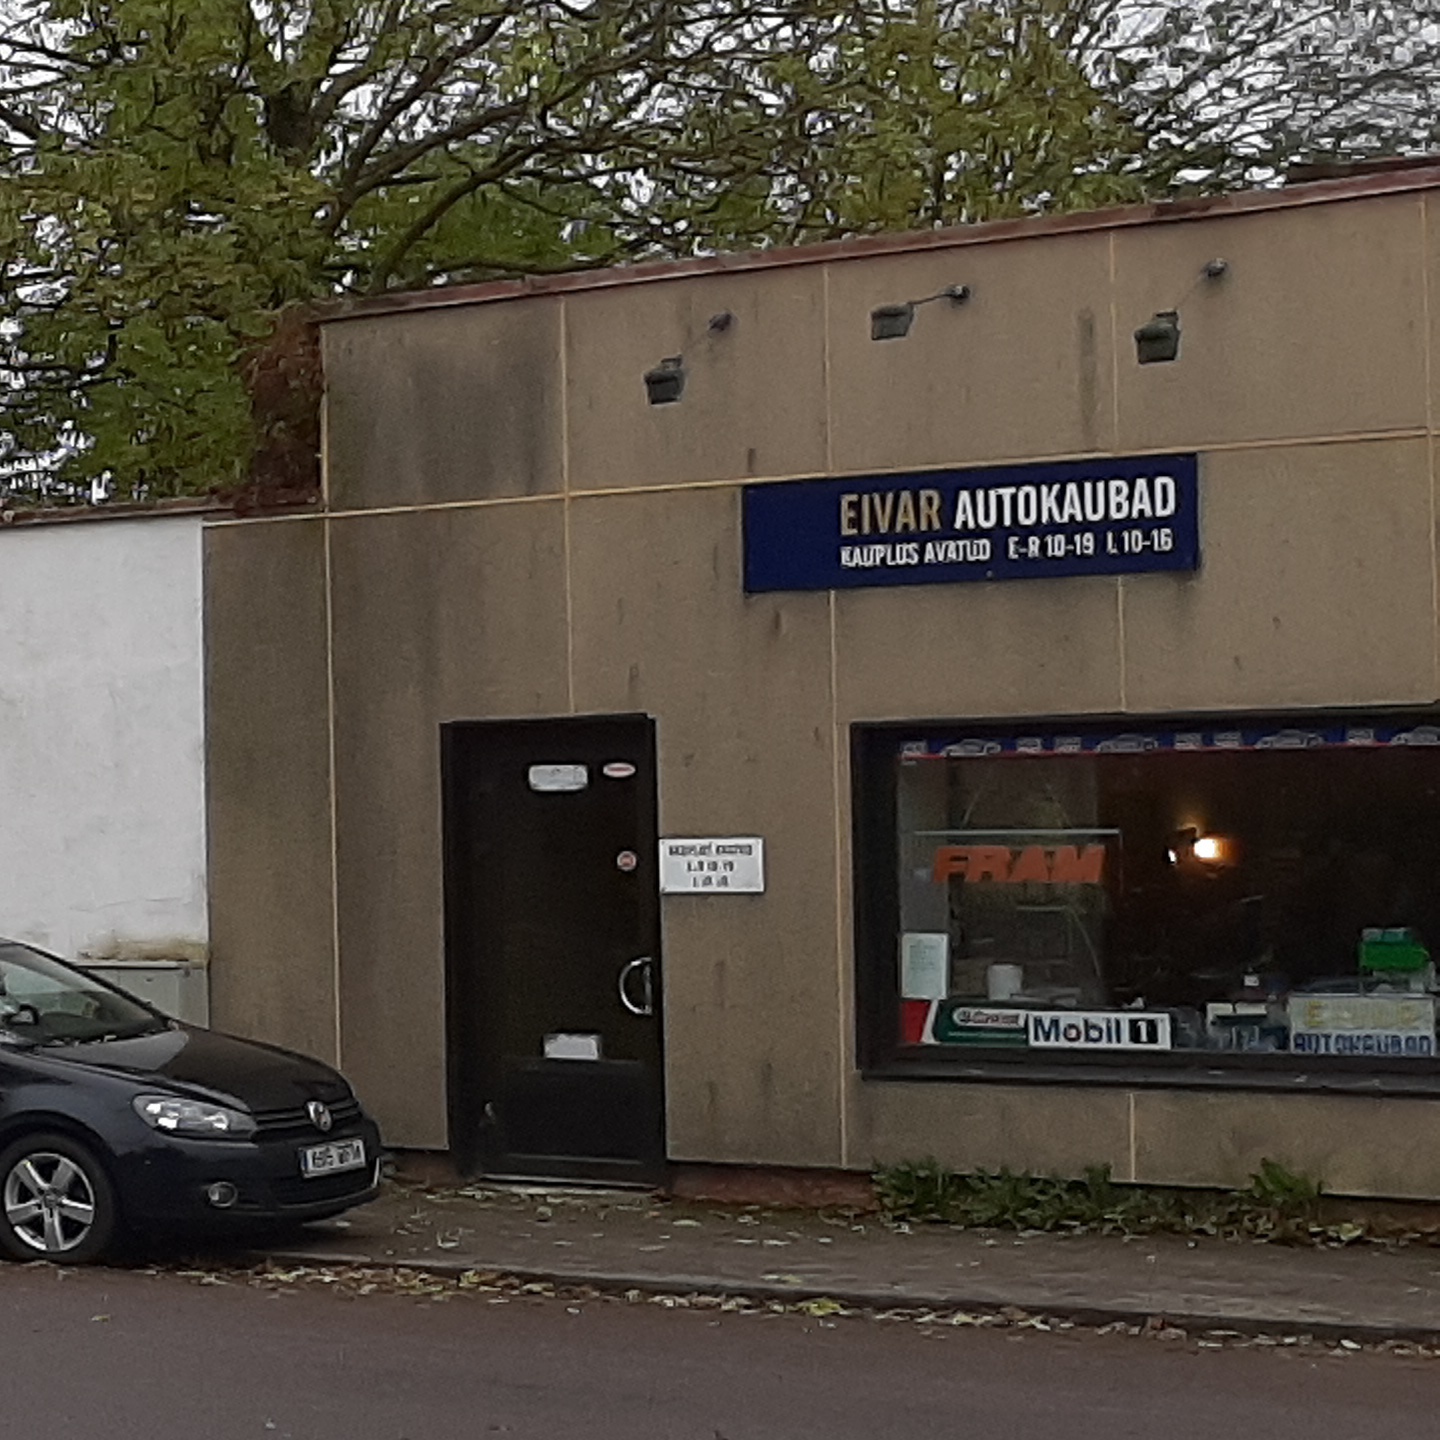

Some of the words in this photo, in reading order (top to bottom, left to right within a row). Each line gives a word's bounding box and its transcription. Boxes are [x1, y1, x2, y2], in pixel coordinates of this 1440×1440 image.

[839, 489, 942, 536] EIVAR
[954, 475, 1176, 530] AUTOKAUBAD
[839, 542, 919, 568] KAUPLUS
[924, 538, 992, 563] AVATUD
[1007, 535, 1040, 560] E-R
[1046, 532, 1095, 557] 10-19
[1121, 527, 1173, 553] 10-16
[933, 845, 1106, 883] FRAM
[1033, 1015, 1122, 1044] Mobil
